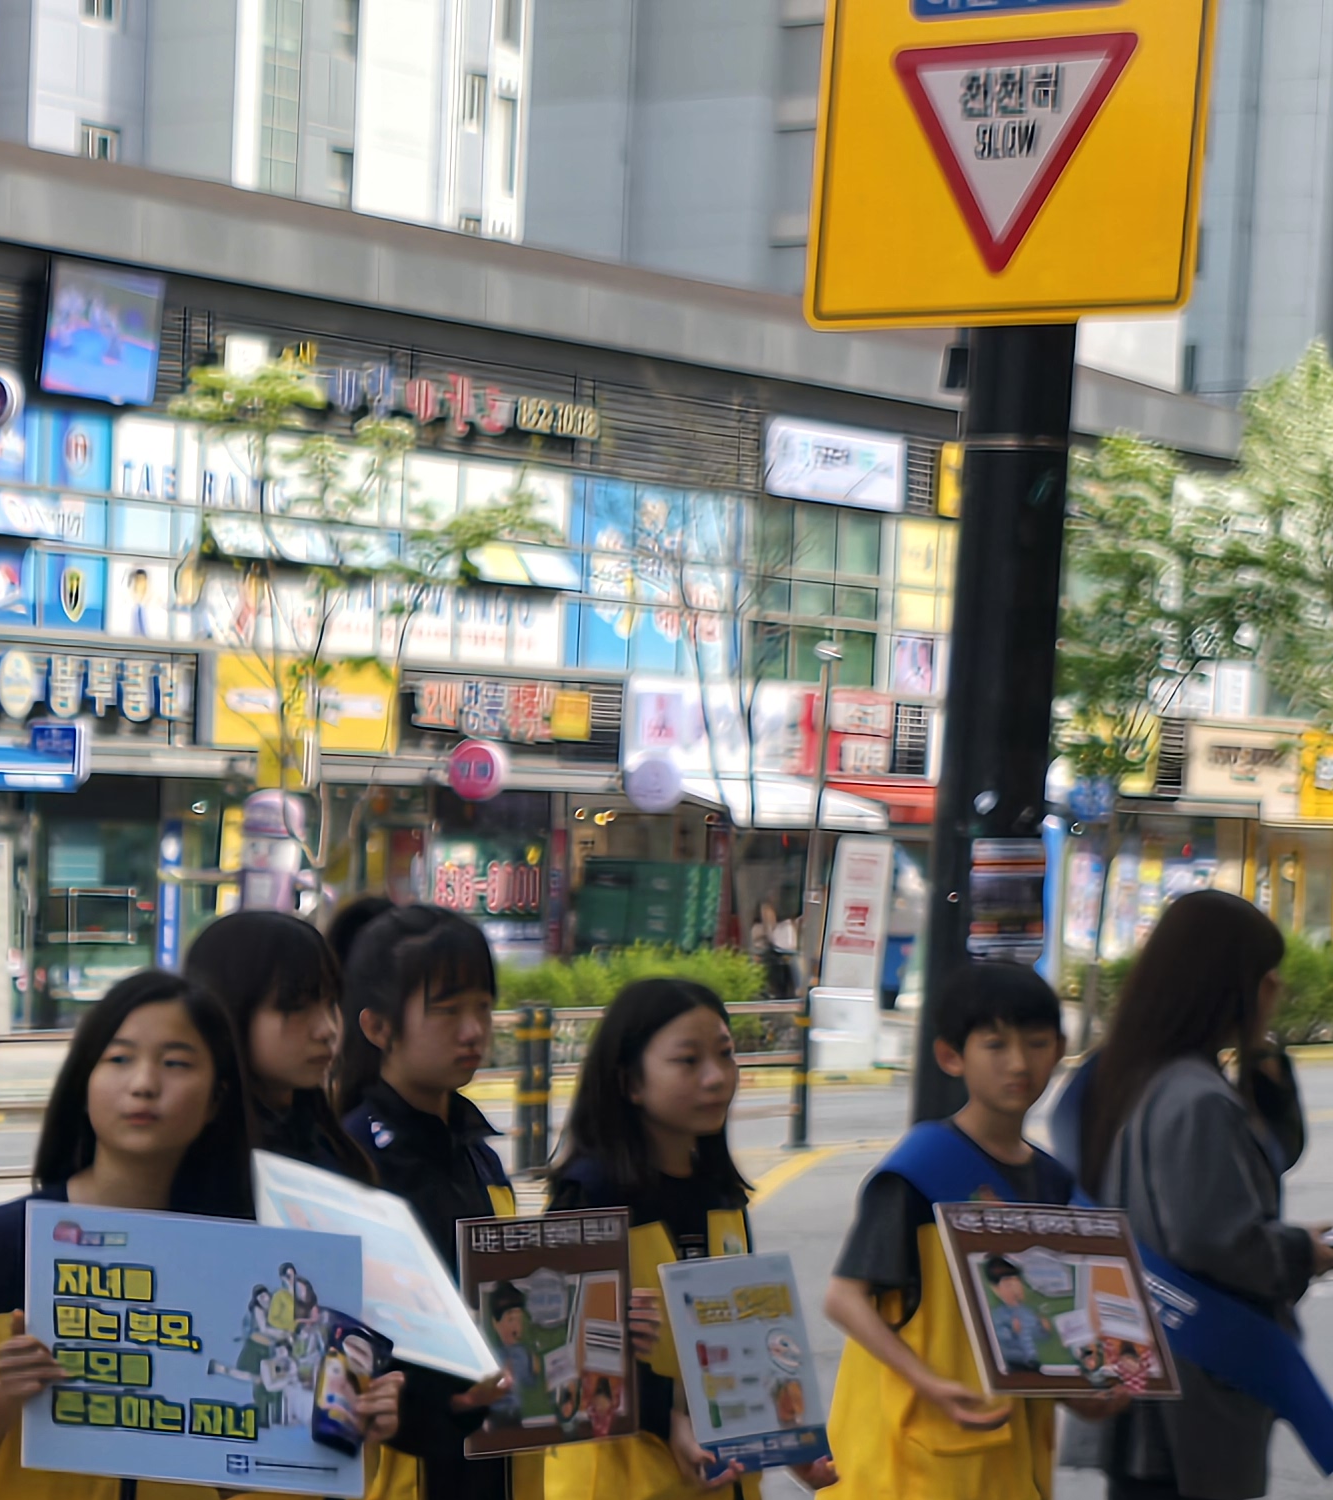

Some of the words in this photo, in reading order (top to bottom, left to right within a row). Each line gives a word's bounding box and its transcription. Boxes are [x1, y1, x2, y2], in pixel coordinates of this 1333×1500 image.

[959, 64, 1064, 120] 천천히
[974, 119, 1039, 160] SLOW
[191, 1403, 256, 1439] 자녀
